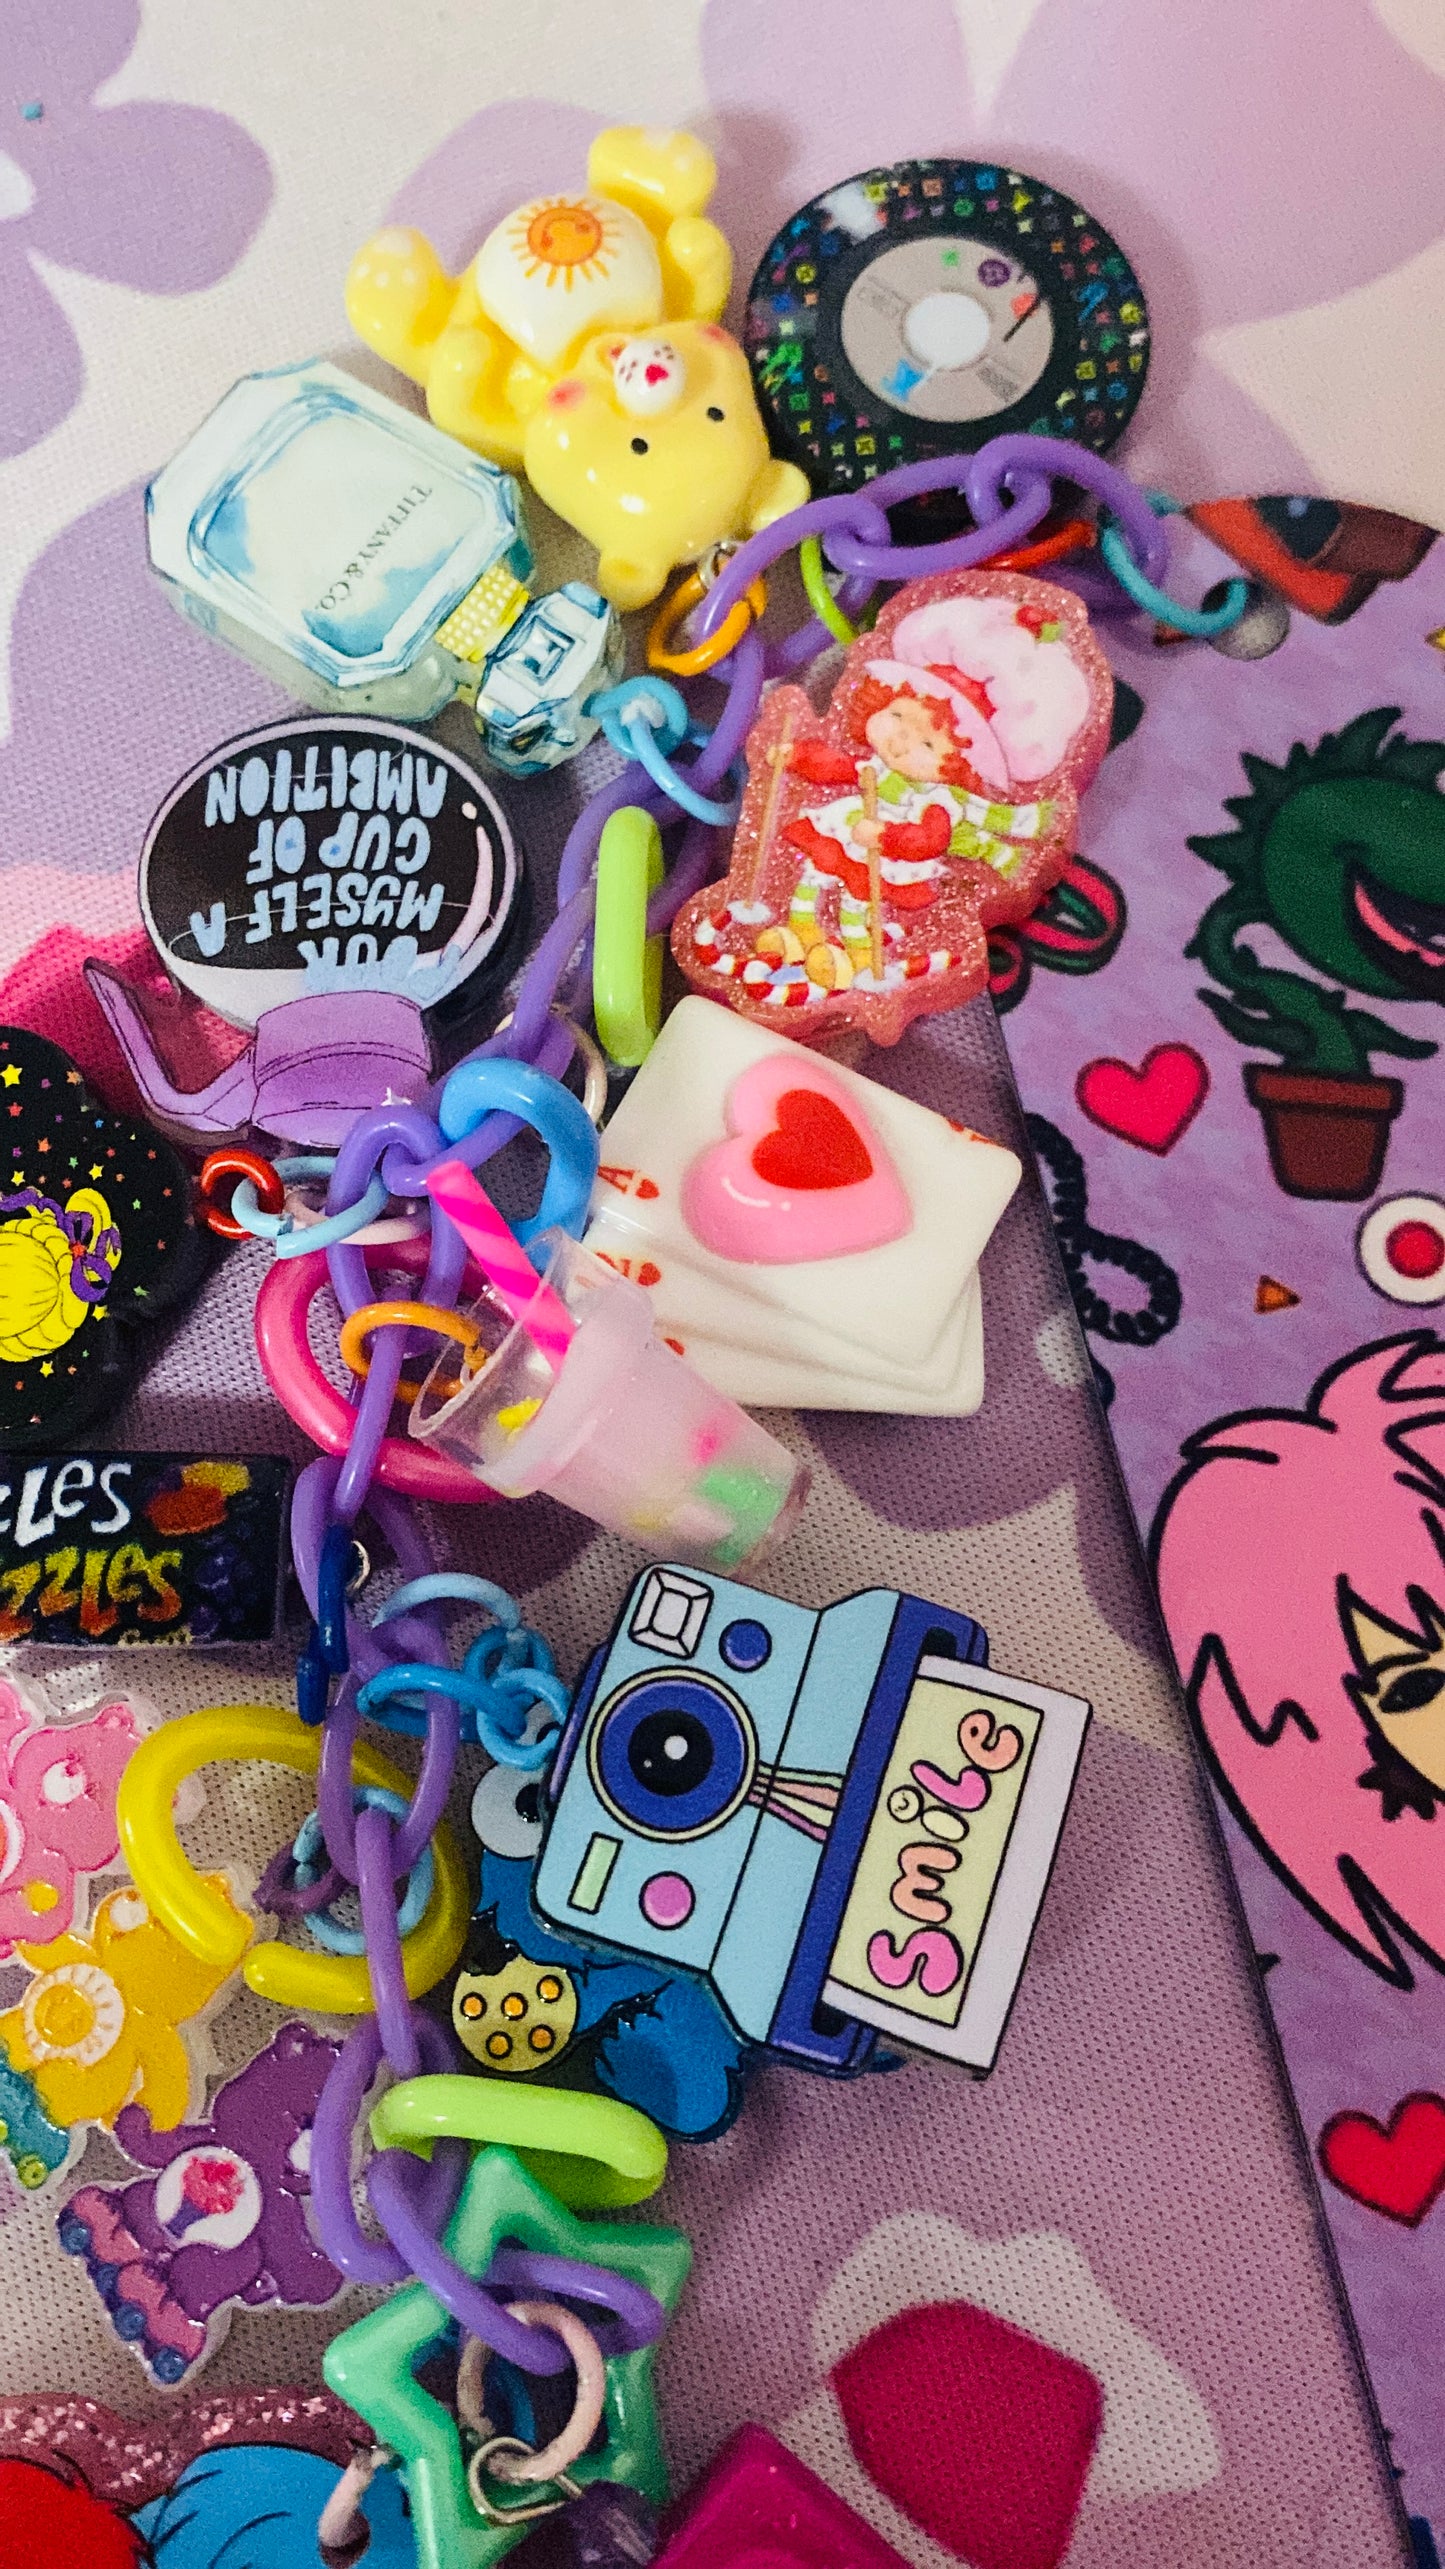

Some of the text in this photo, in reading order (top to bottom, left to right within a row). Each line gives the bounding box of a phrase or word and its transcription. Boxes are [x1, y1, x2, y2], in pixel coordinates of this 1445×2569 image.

[204, 745, 448, 828] AMBITION
[245, 811, 432, 885] CUP OF
[189, 873, 445, 957] MYSELF A
